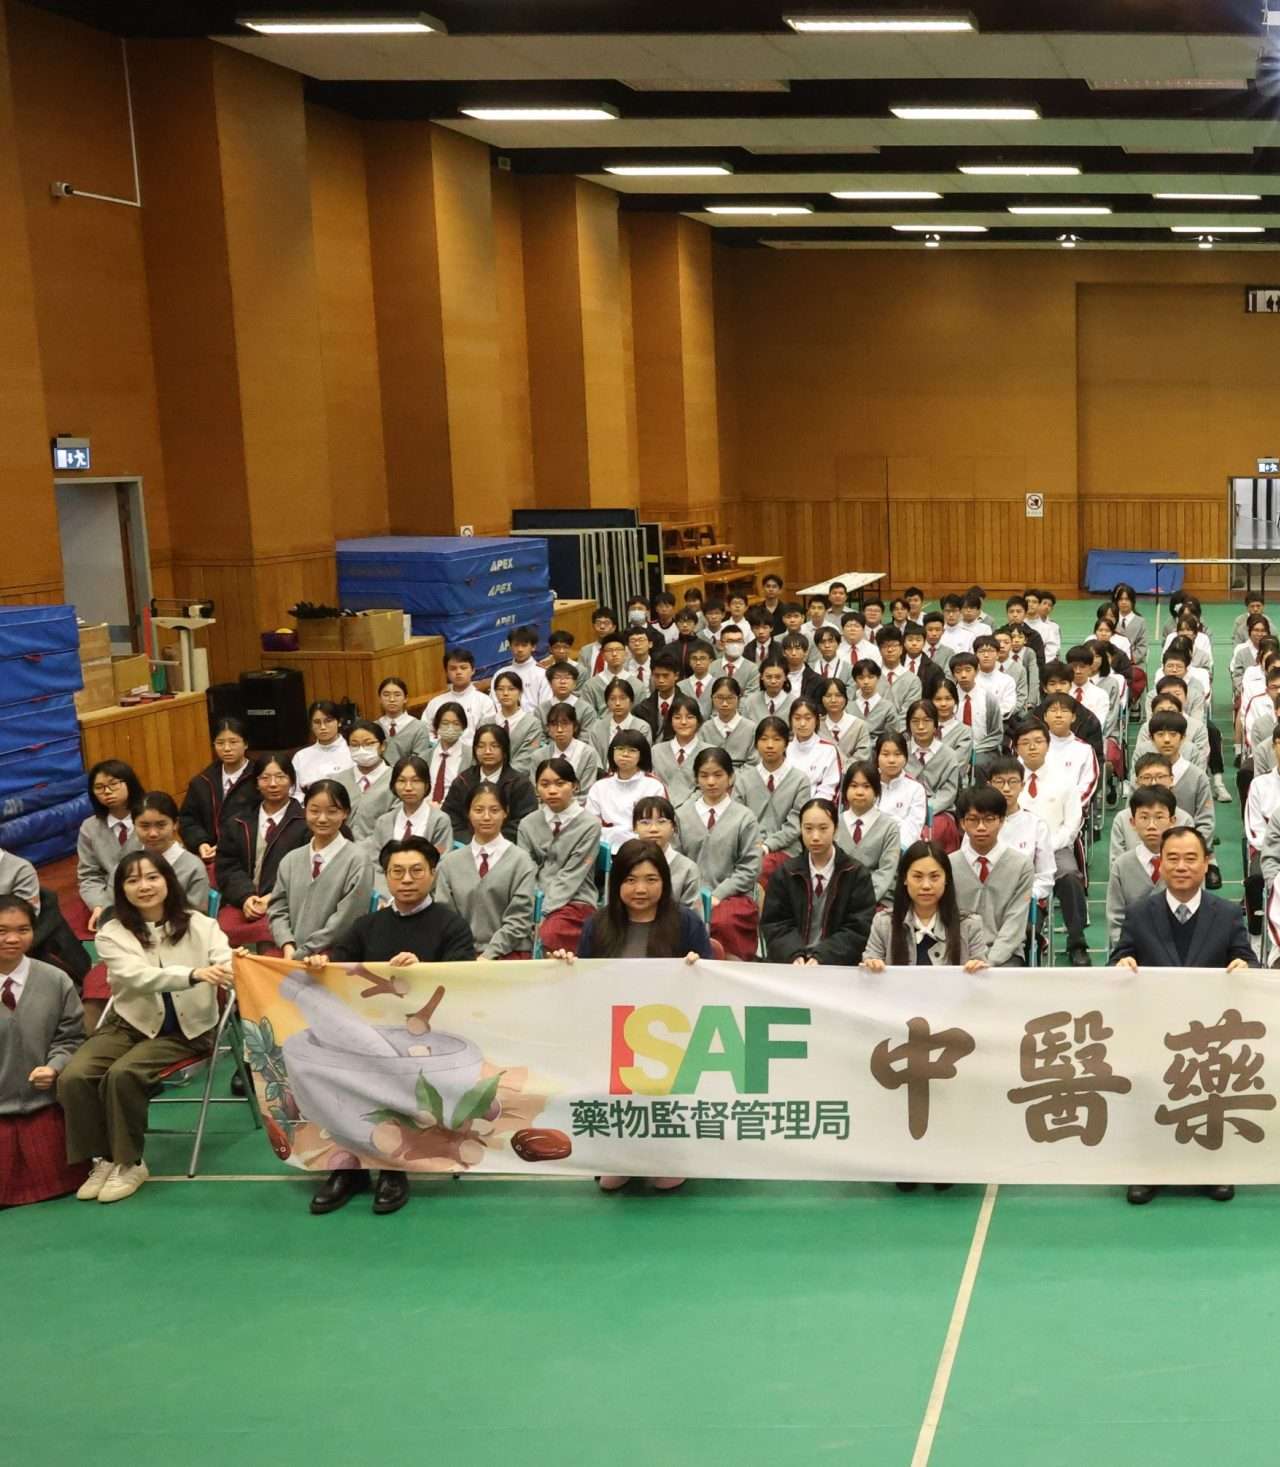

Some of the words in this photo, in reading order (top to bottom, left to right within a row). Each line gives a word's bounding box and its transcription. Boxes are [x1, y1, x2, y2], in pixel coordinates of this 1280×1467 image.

[490, 558, 513, 572] APEX
[488, 582, 512, 597] APEX
[498, 639, 511, 653] AP
[609, 1004, 811, 1097] ISAF
[569, 1099, 851, 1142] 藥物監督管理局
